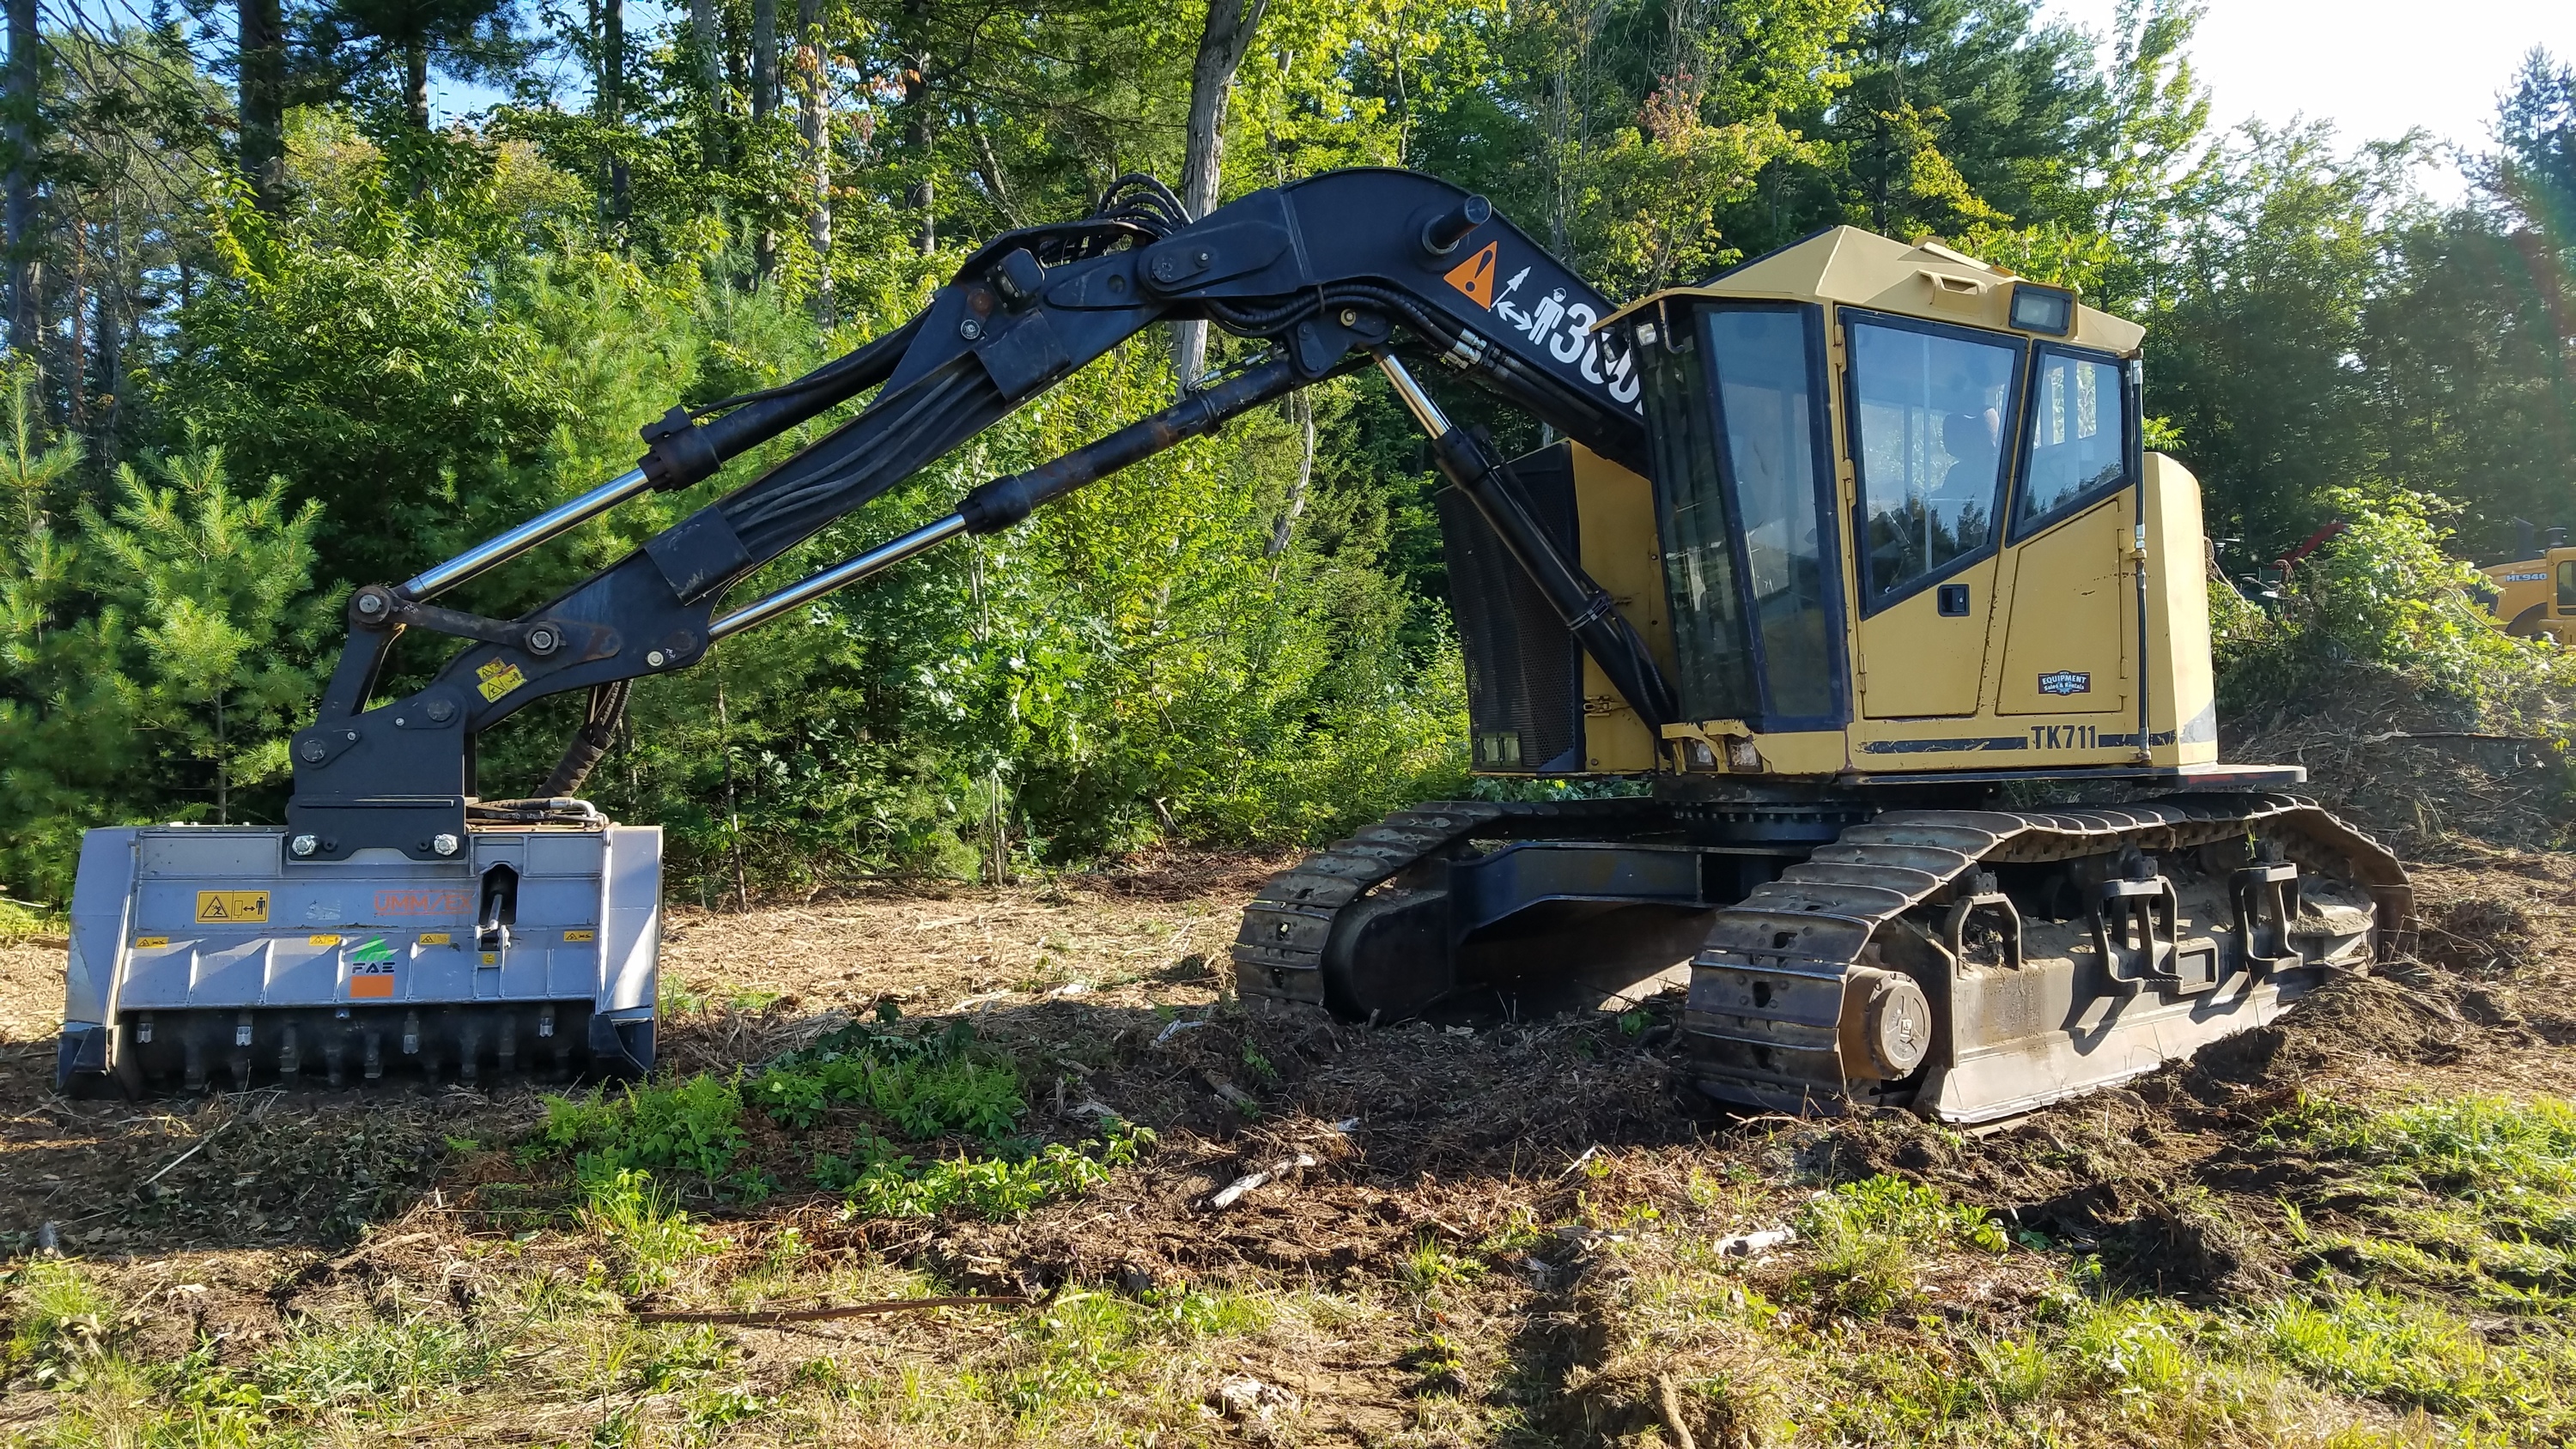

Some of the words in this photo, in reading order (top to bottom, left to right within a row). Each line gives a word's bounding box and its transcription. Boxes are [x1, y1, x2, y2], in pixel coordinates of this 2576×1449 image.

[2506, 573, 2547, 581] HL940
[2042, 675, 2087, 684] EQUIPMENT
[2030, 724, 2096, 750] TK711
[374, 894, 473, 912] UMM/EX
[351, 961, 396, 973] FAE
